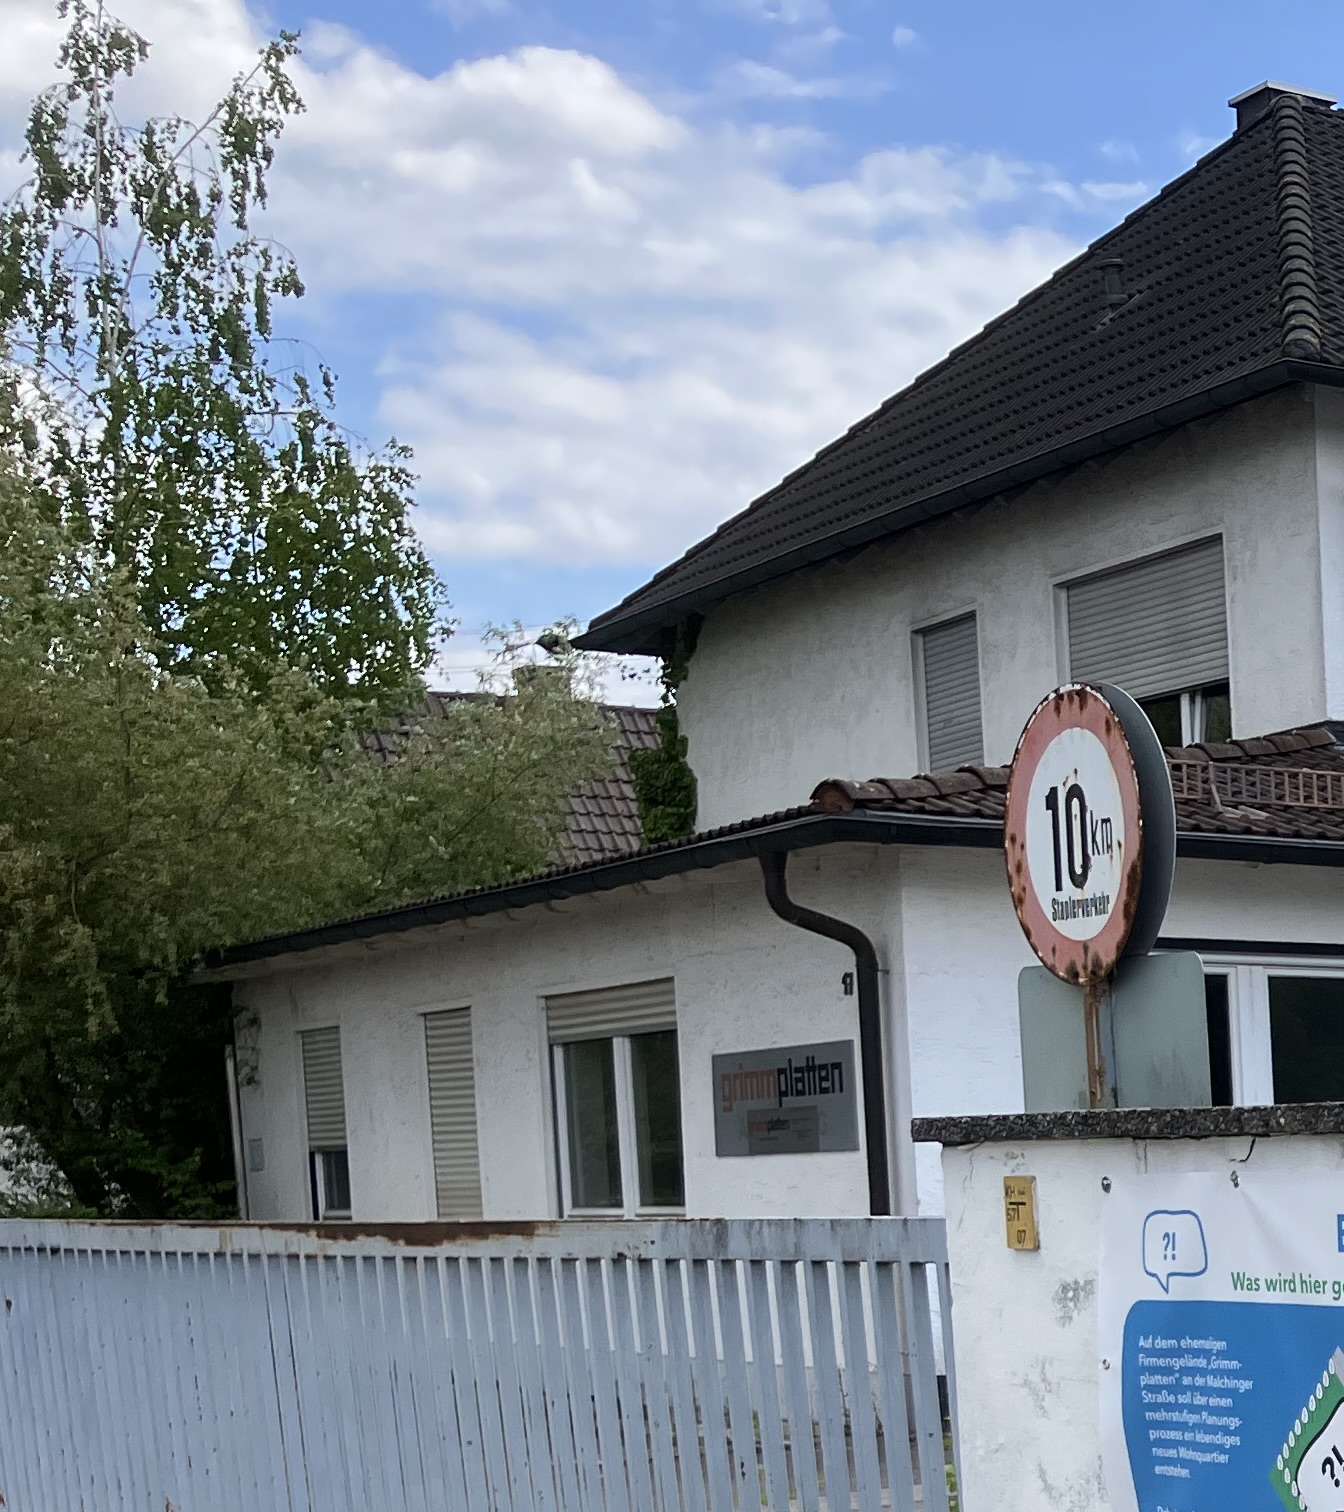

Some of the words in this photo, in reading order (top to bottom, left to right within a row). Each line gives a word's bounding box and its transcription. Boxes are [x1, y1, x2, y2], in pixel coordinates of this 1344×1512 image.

[1045, 783, 1089, 891] 10
[1090, 810, 1113, 856] km
[721, 1055, 844, 1112] grimmplatten
[1163, 1232, 1176, 1261] ?!
[1231, 1272, 1260, 1291] Was
[1265, 1272, 1296, 1293] wird
[1300, 1273, 1327, 1294] hier
